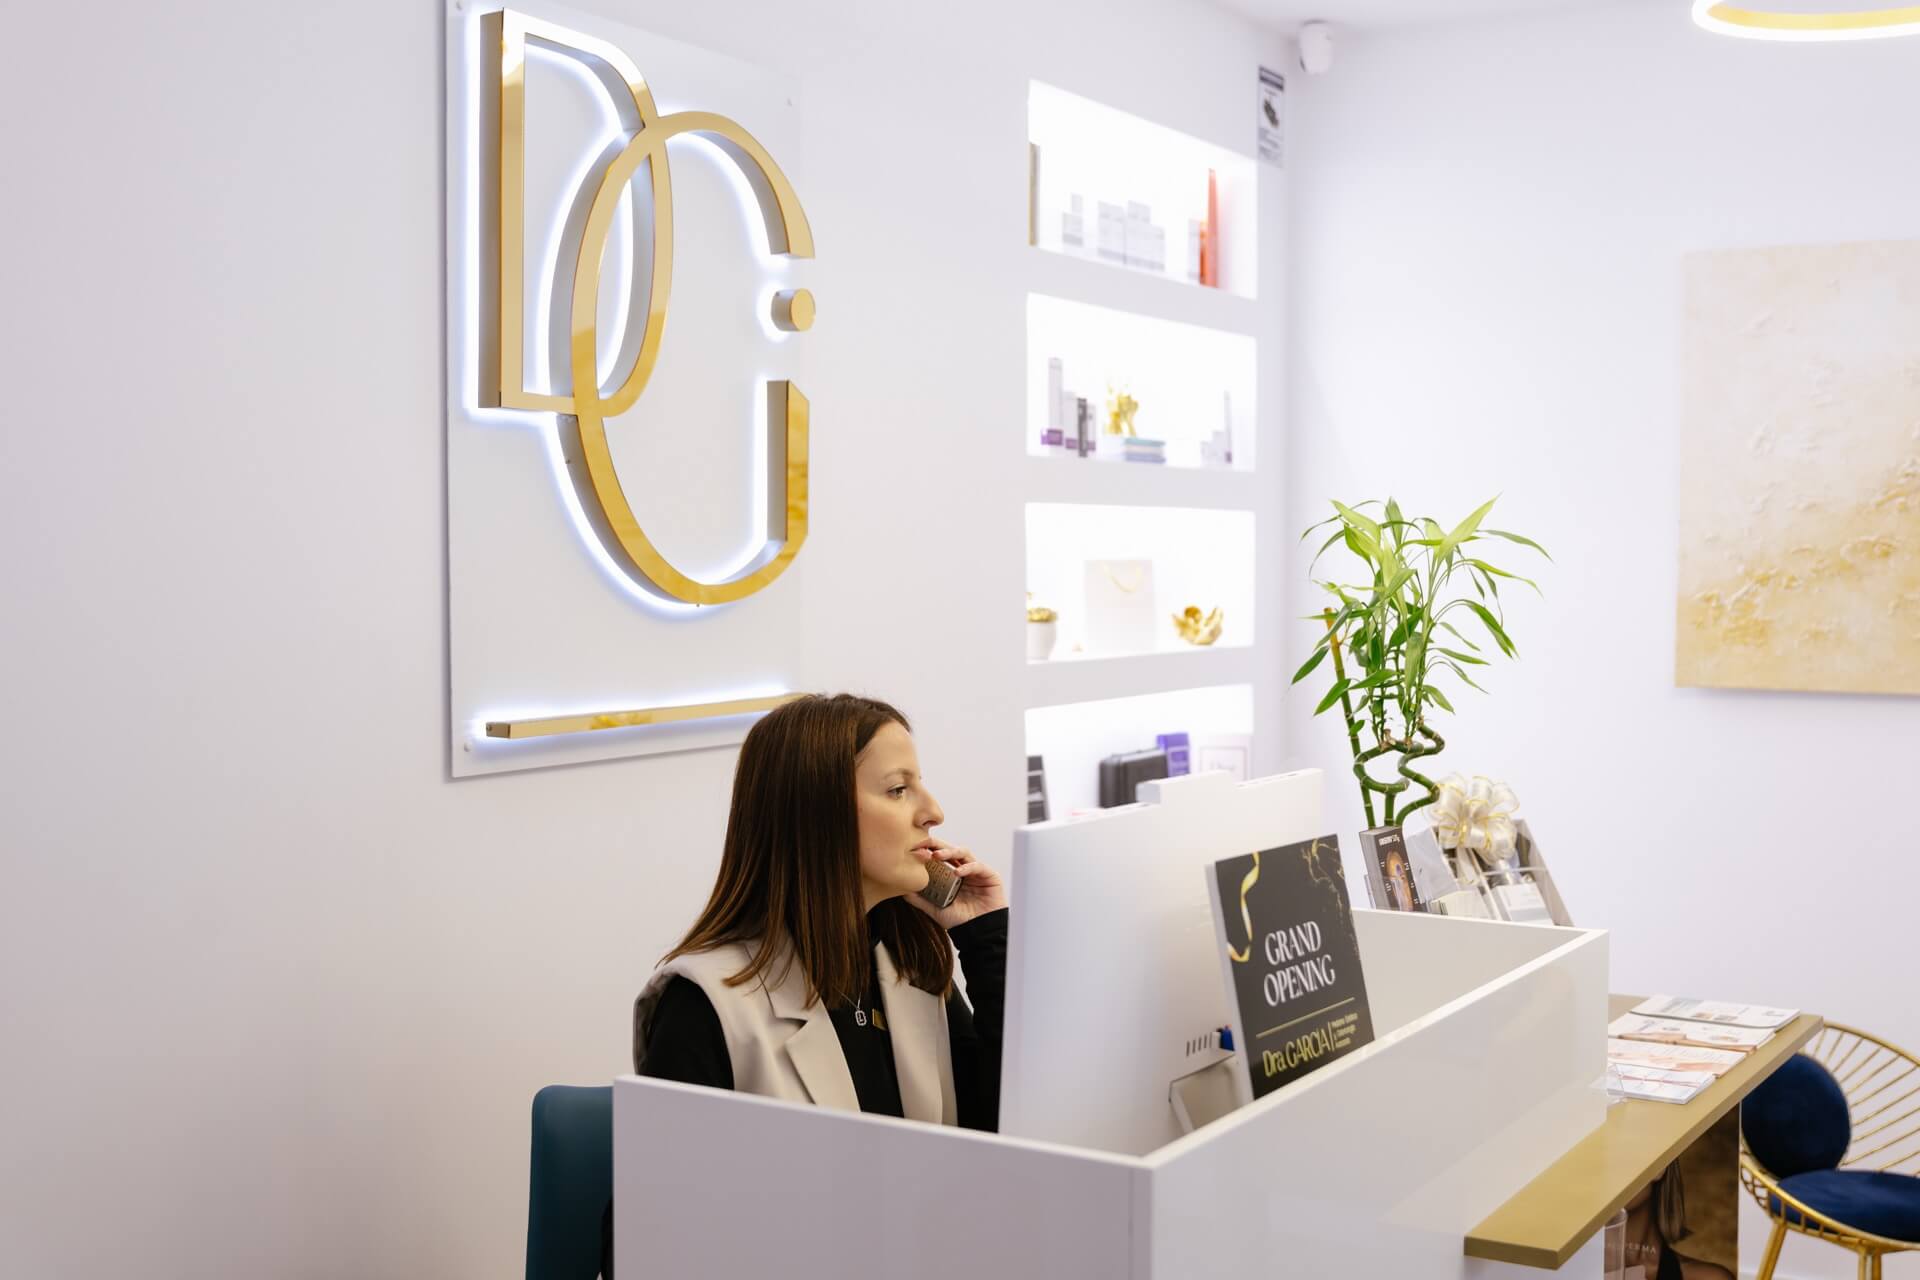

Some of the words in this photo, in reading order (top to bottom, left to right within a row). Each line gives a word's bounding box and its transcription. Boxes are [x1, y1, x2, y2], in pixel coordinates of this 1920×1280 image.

[1264, 921, 1321, 966] GRAND
[1263, 954, 1336, 1007] OPENING
[1262, 1050, 1287, 1077] Dra
